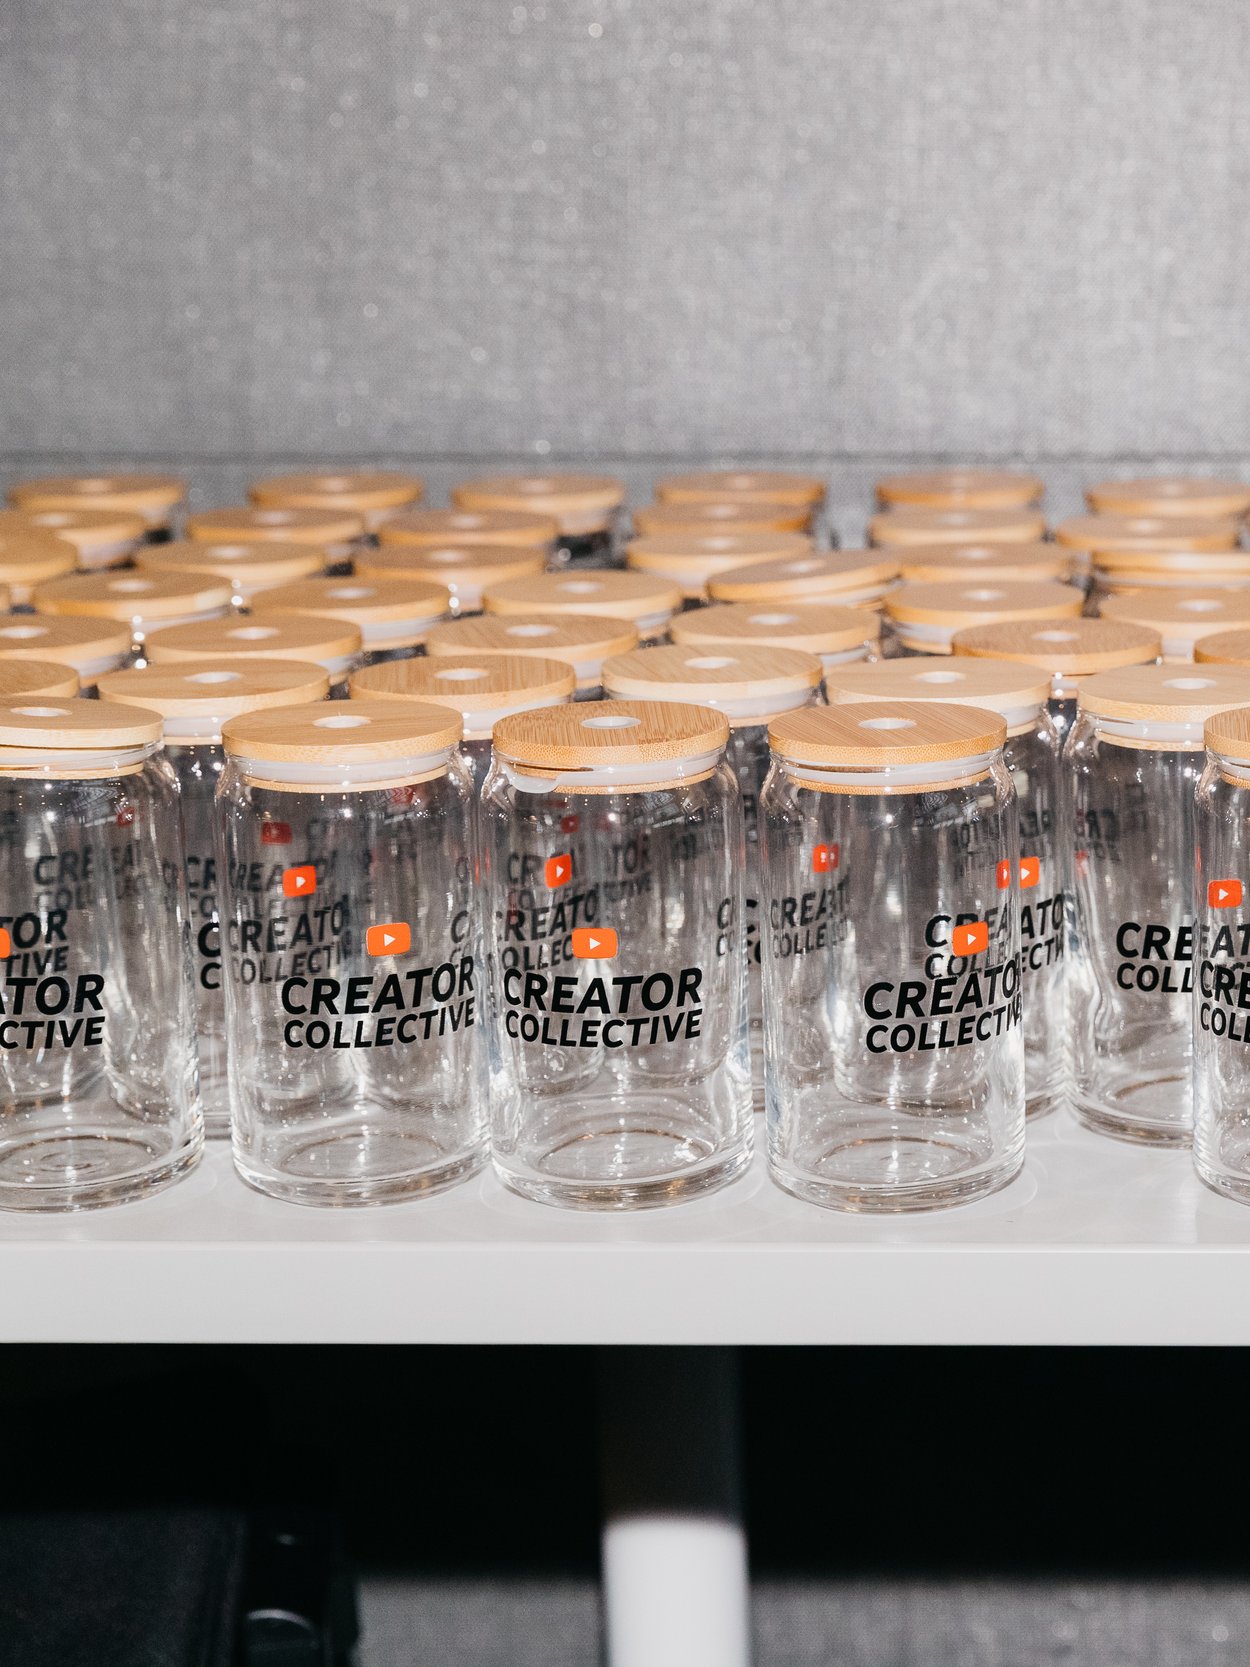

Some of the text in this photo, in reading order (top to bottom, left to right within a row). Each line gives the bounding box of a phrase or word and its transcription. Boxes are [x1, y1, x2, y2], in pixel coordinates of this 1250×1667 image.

[0, 974, 105, 1015] TOR
[281, 955, 475, 1015] CREATOR
[503, 967, 703, 1015] CREATOR
[284, 998, 475, 1049] COLLECTIVE
[505, 1009, 703, 1048] COLLECTIVE
